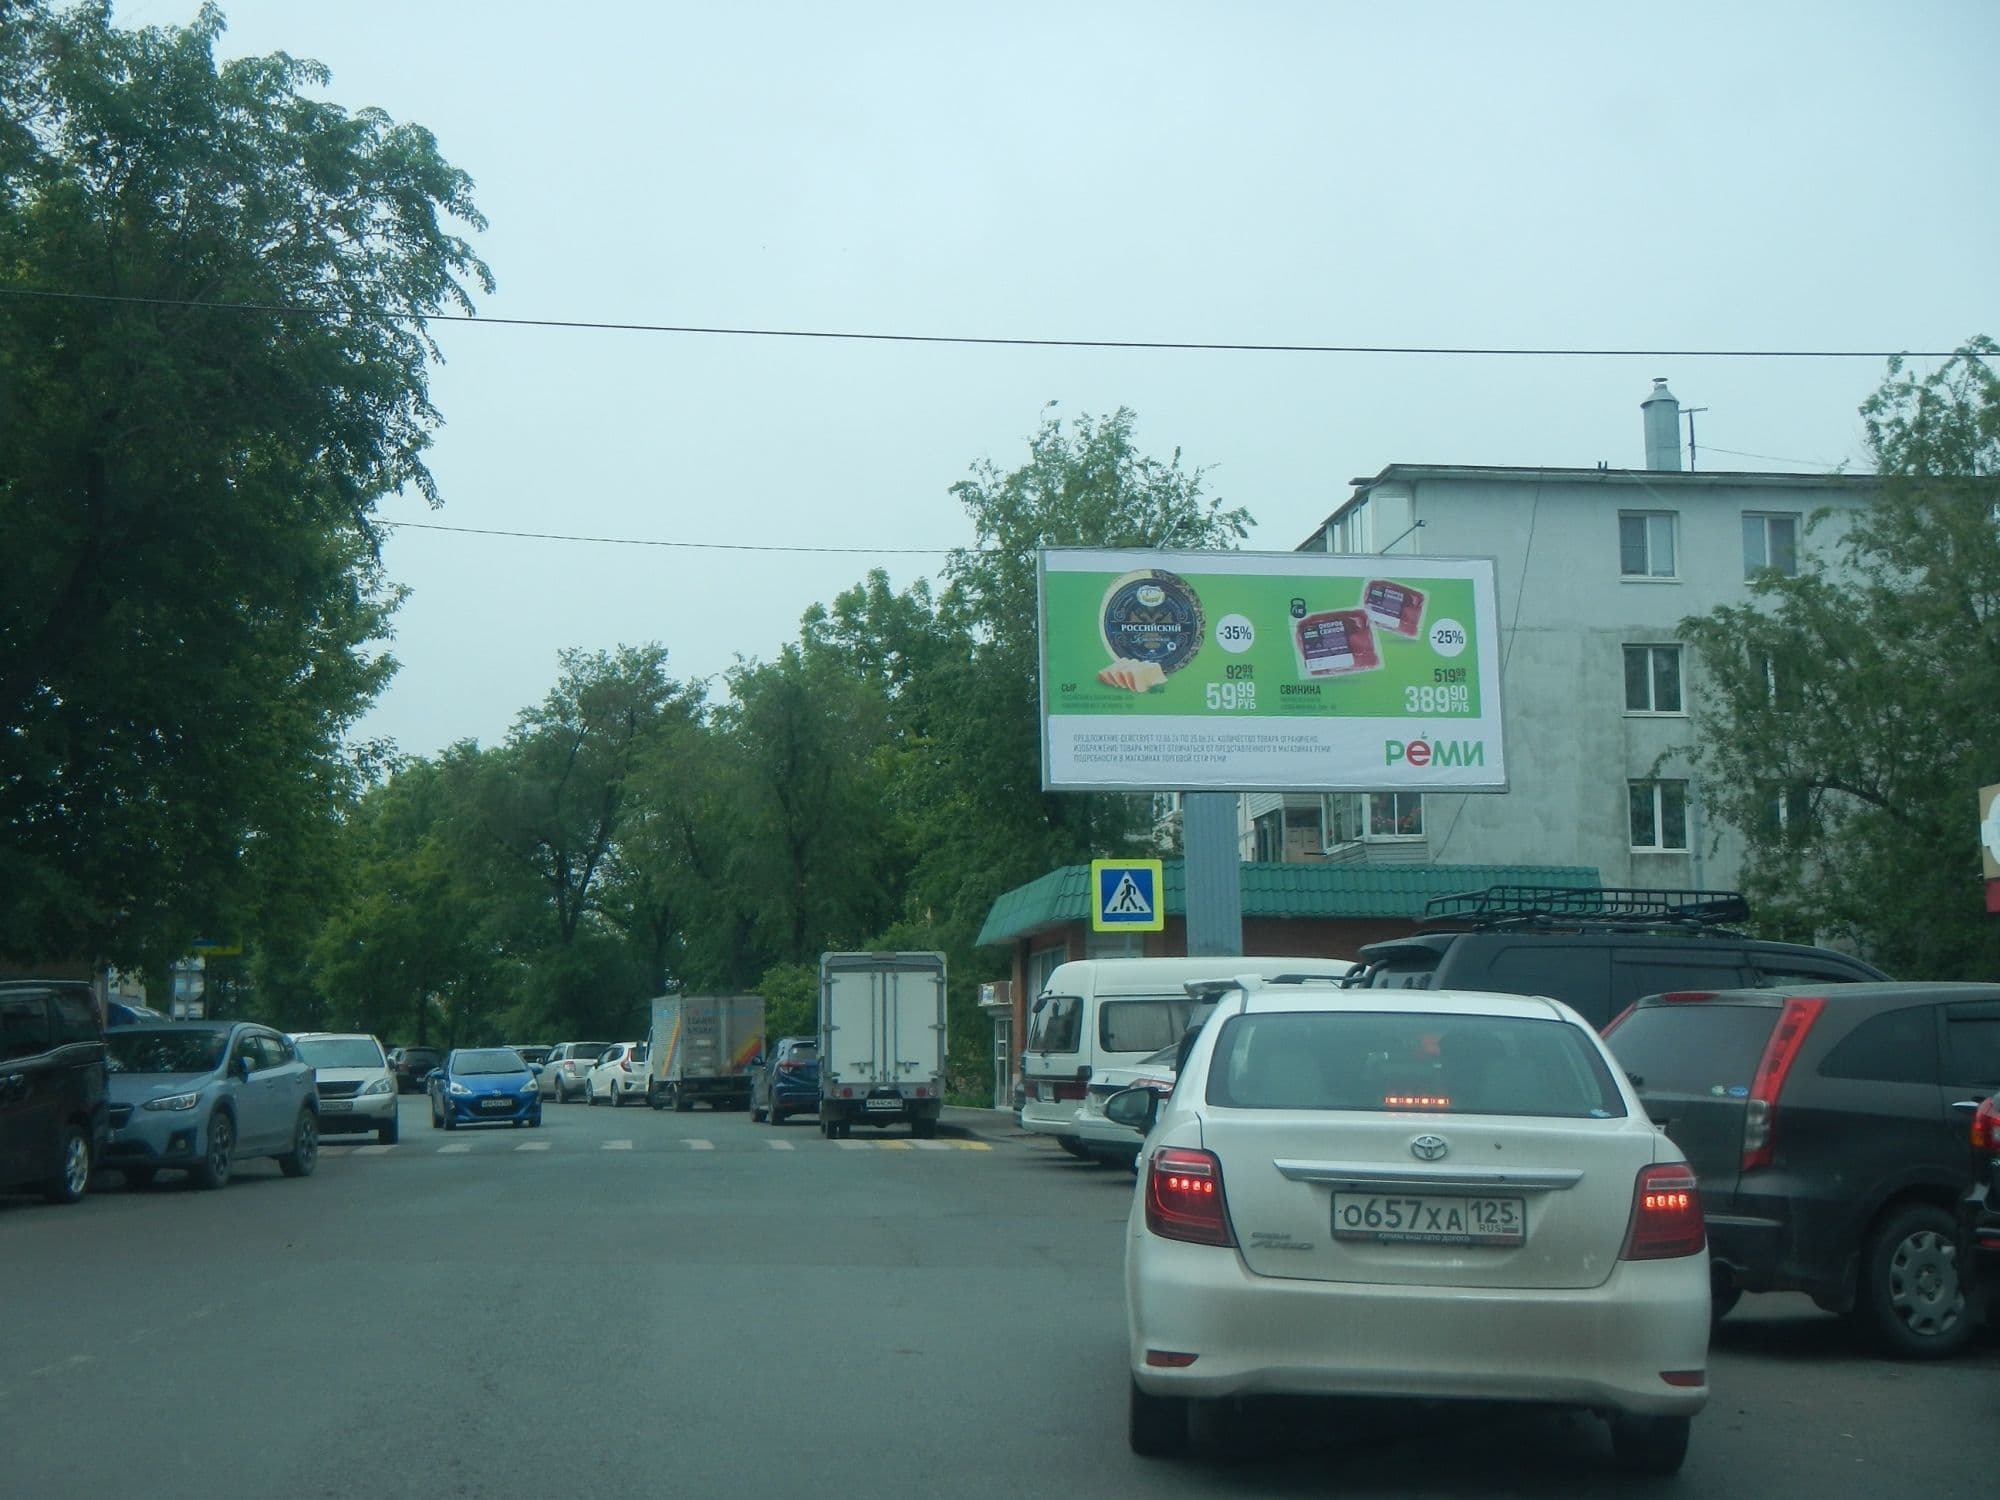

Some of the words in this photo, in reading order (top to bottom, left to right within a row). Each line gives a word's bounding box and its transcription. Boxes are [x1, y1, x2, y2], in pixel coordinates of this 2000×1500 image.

[1121, 623, 1181, 633] РОССИЙСКИЙ
[1219, 625, 1251, 640] -35%
[1432, 629, 1464, 645] -25%
[1226, 665, 1242, 680] 92
[1434, 668, 1455, 683] 519
[1061, 683, 1077, 693] СЫР
[1280, 684, 1321, 695] СВИНИНА
[1206, 682, 1237, 710] 59
[1237, 681, 1255, 698] 99
[1405, 685, 1450, 713] 389
[1450, 685, 1468, 701] 90
[1238, 699, 1256, 711] РУБ
[1451, 701, 1469, 713] РУБ
[1470, 1200, 1514, 1225] 125
[1479, 1224, 1502, 1233] RUS
[1441, 1235, 1470, 1243] ДОРОГО
